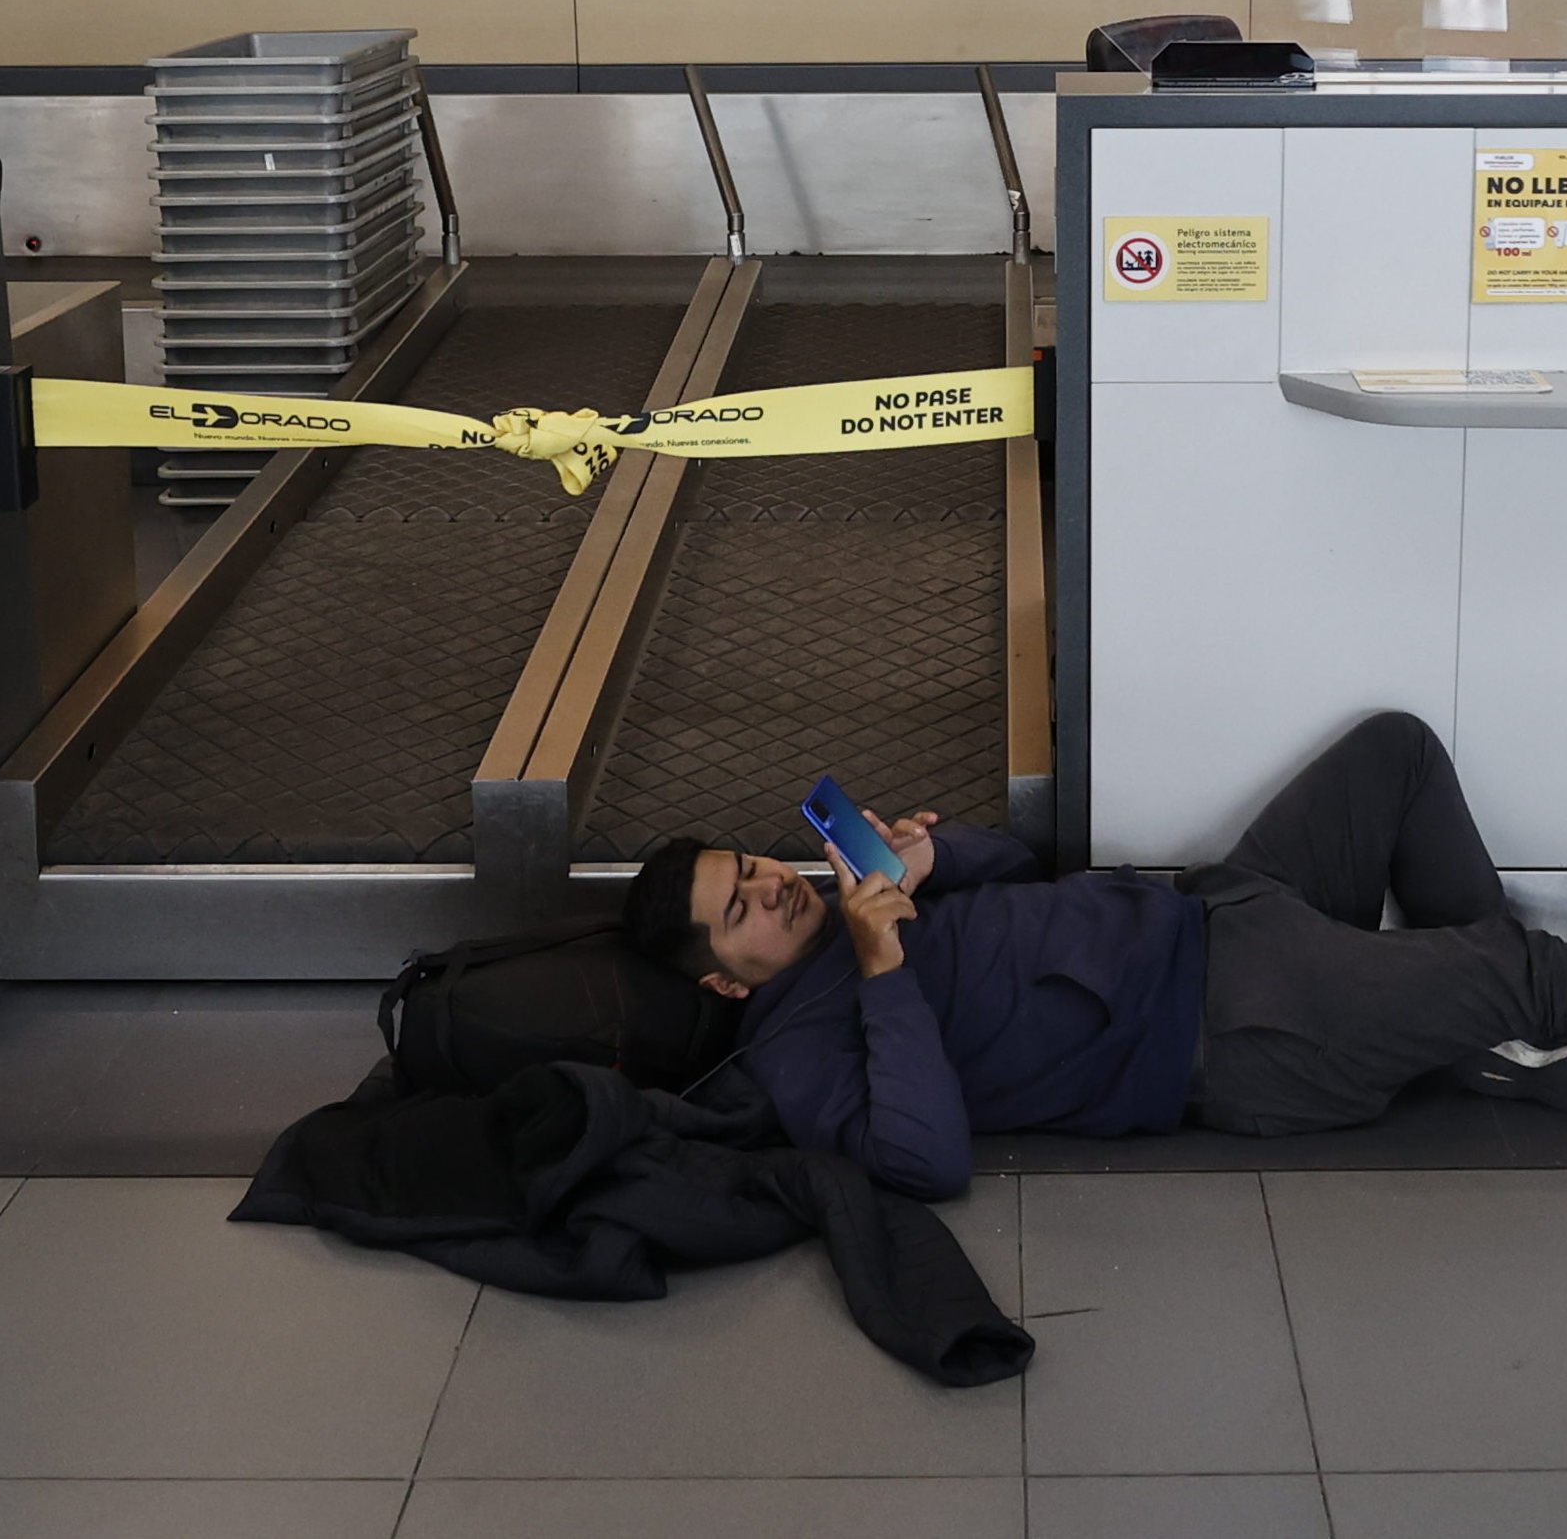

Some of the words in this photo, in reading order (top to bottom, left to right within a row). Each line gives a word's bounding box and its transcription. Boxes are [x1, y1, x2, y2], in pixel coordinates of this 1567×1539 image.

[1487, 177, 1524, 194] NO
[1487, 199, 1503, 208] EN
[1505, 199, 1563, 208] EQUIPAJE
[1177, 229, 1210, 239] Peligro
[1213, 229, 1251, 237] sistema
[1177, 240, 1256, 248] electromecánico
[875, 393, 909, 411] NO
[915, 388, 972, 408] PASE
[149, 405, 193, 420] EL
[192, 403, 351, 432] DORADO
[841, 417, 874, 435] DO
[879, 413, 928, 431] NOT
[932, 406, 1003, 429] ENTER
[667, 438, 699, 447] Nuevas
[701, 436, 751, 446] conexiones.
